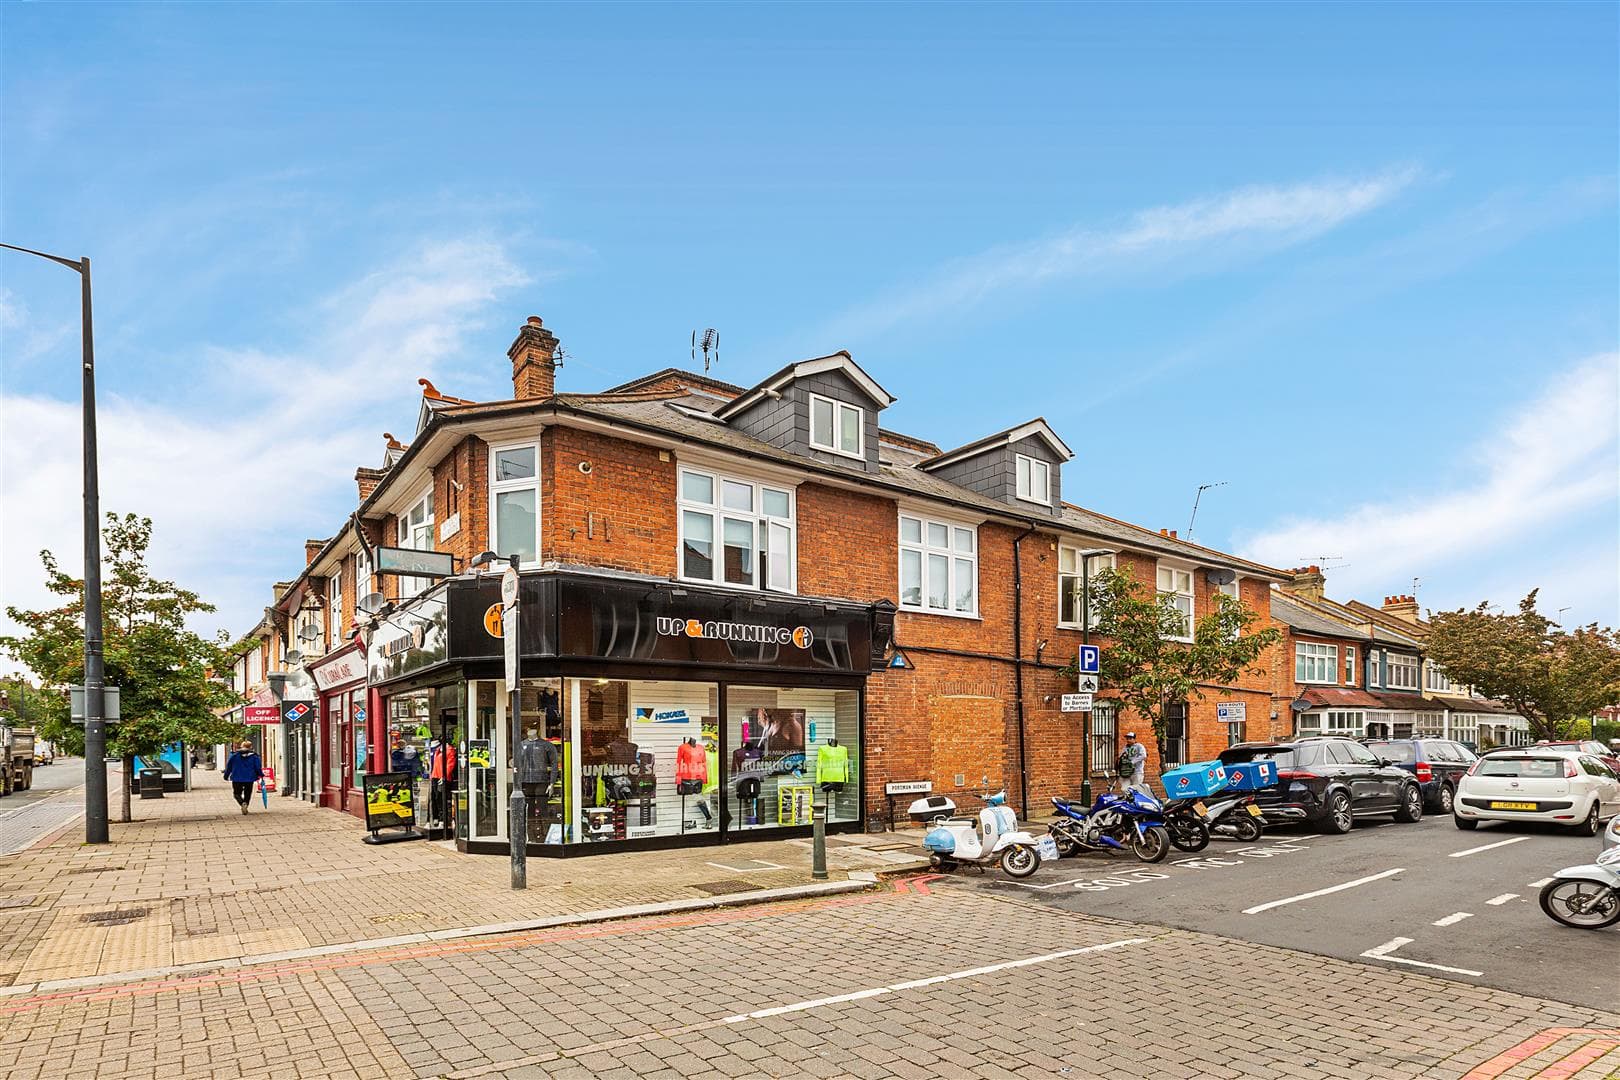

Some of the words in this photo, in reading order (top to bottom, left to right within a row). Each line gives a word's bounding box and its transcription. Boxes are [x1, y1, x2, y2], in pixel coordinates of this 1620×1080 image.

[1084, 649, 1096, 669] P
[1217, 770, 1224, 778] L
[1074, 872, 1171, 891] SOLO
